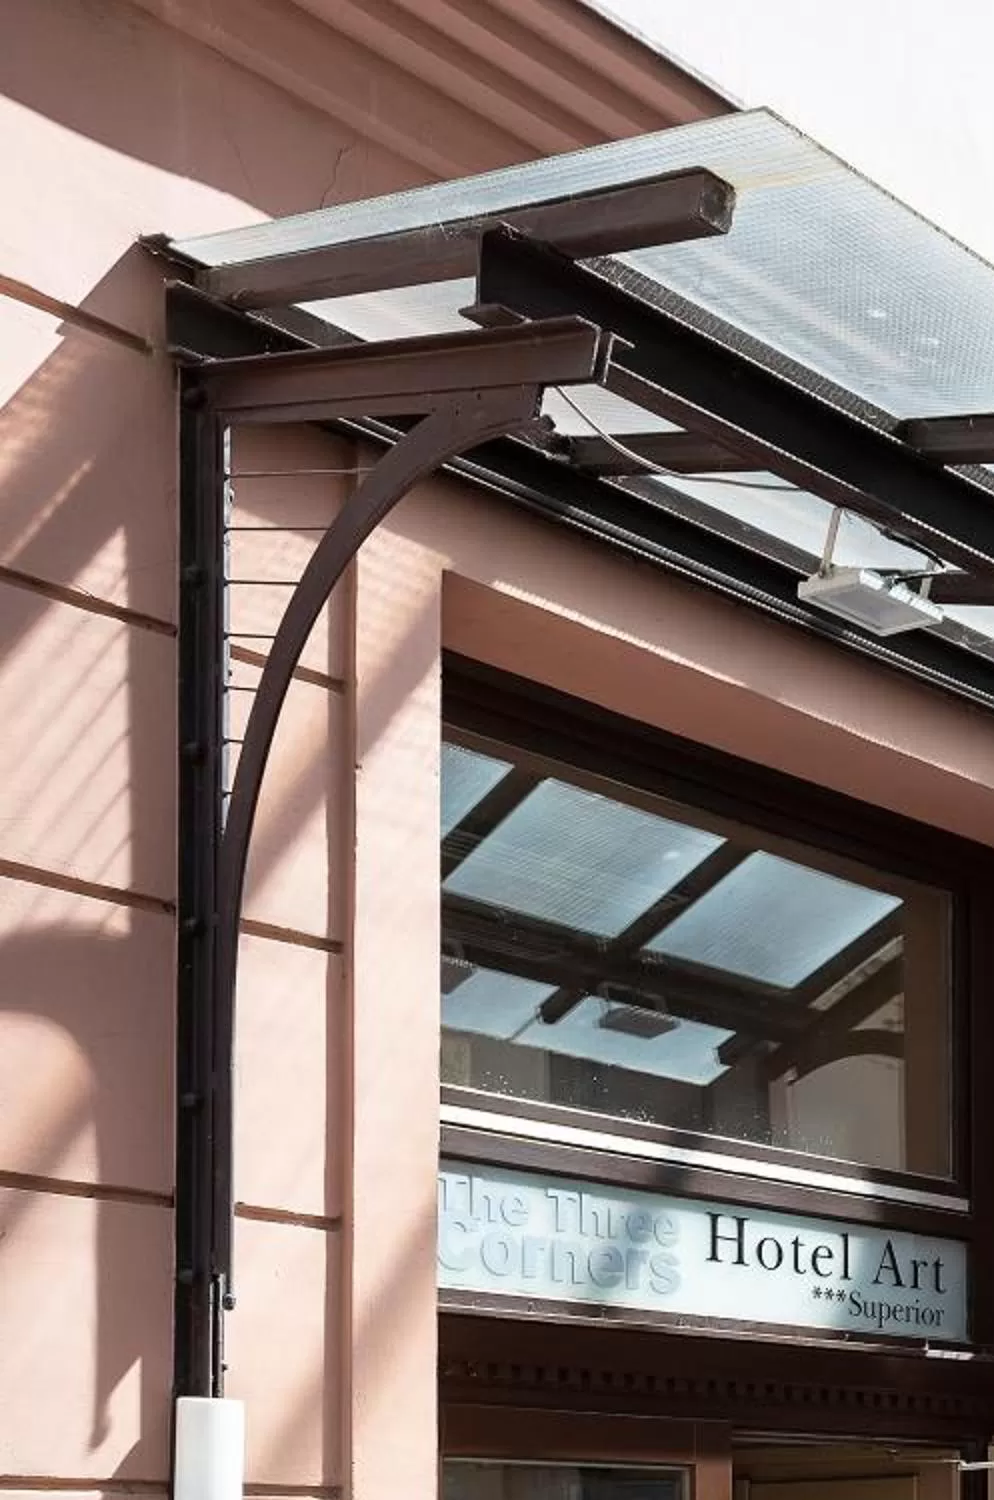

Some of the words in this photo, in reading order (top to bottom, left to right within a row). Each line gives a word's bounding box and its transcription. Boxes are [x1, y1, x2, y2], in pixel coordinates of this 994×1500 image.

[438, 1174, 529, 1227] The
[545, 1190, 679, 1247] Three
[438, 1214, 683, 1295] Corners
[705, 1211, 852, 1281] Hotel
[872, 1238, 947, 1294] Art
